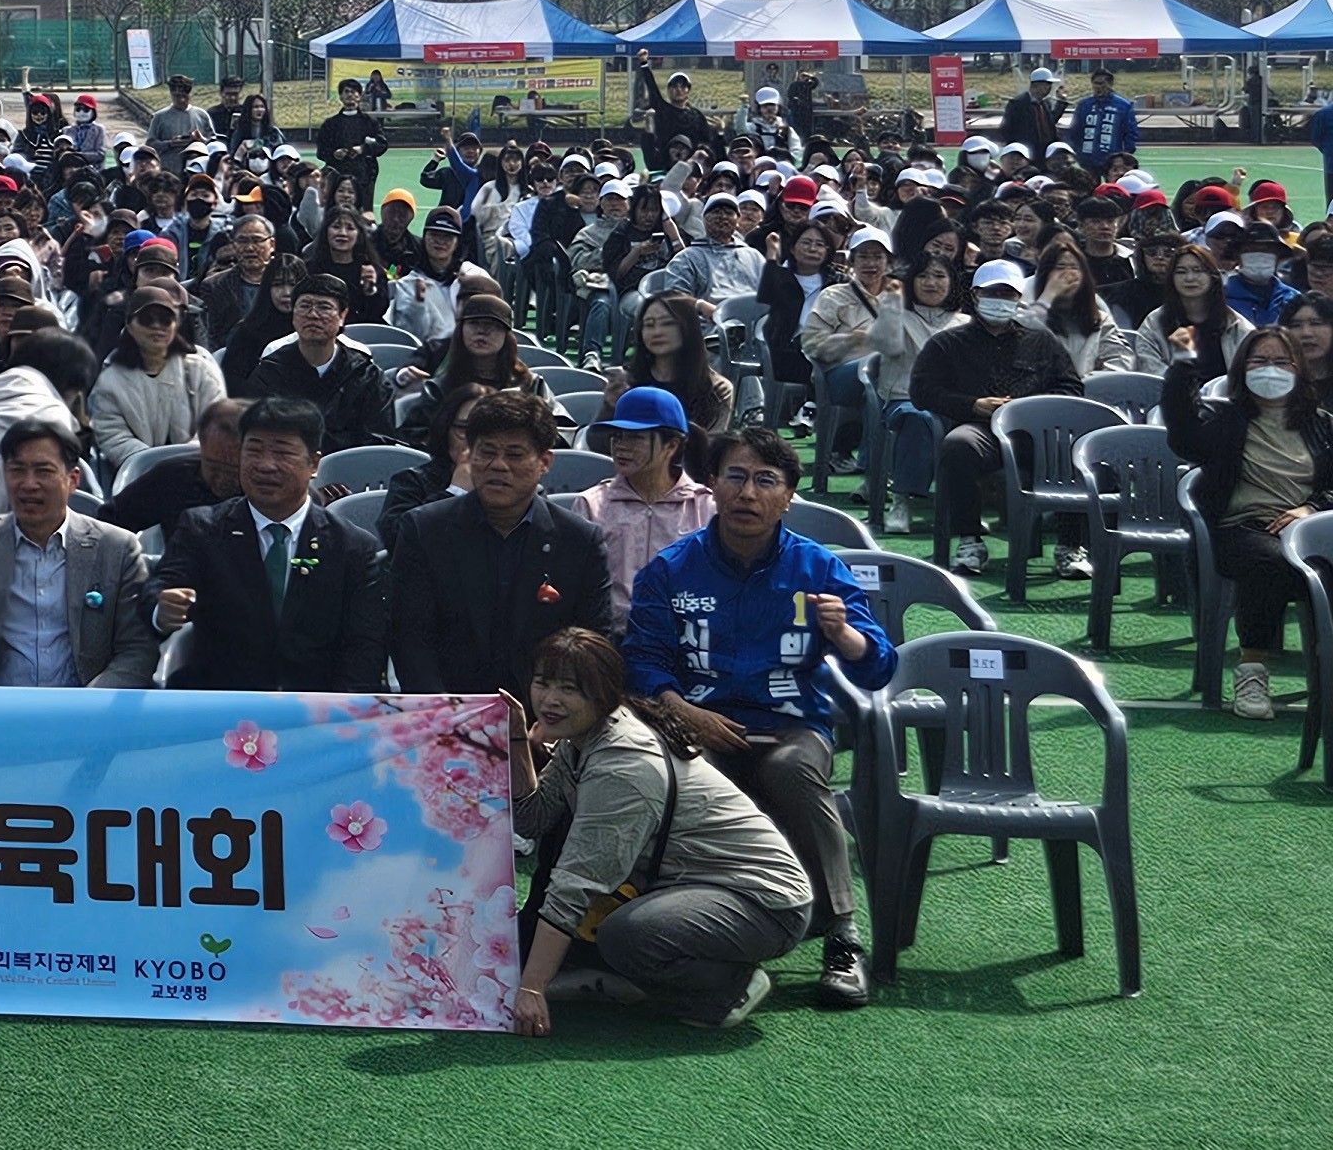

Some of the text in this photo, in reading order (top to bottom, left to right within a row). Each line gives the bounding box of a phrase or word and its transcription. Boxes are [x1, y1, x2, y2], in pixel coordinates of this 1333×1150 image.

[671, 596, 718, 614] 민주당
[792, 590, 807, 626] 1
[134, 957, 228, 982] KYOBO
[150, 984, 209, 1001] 교보생명
